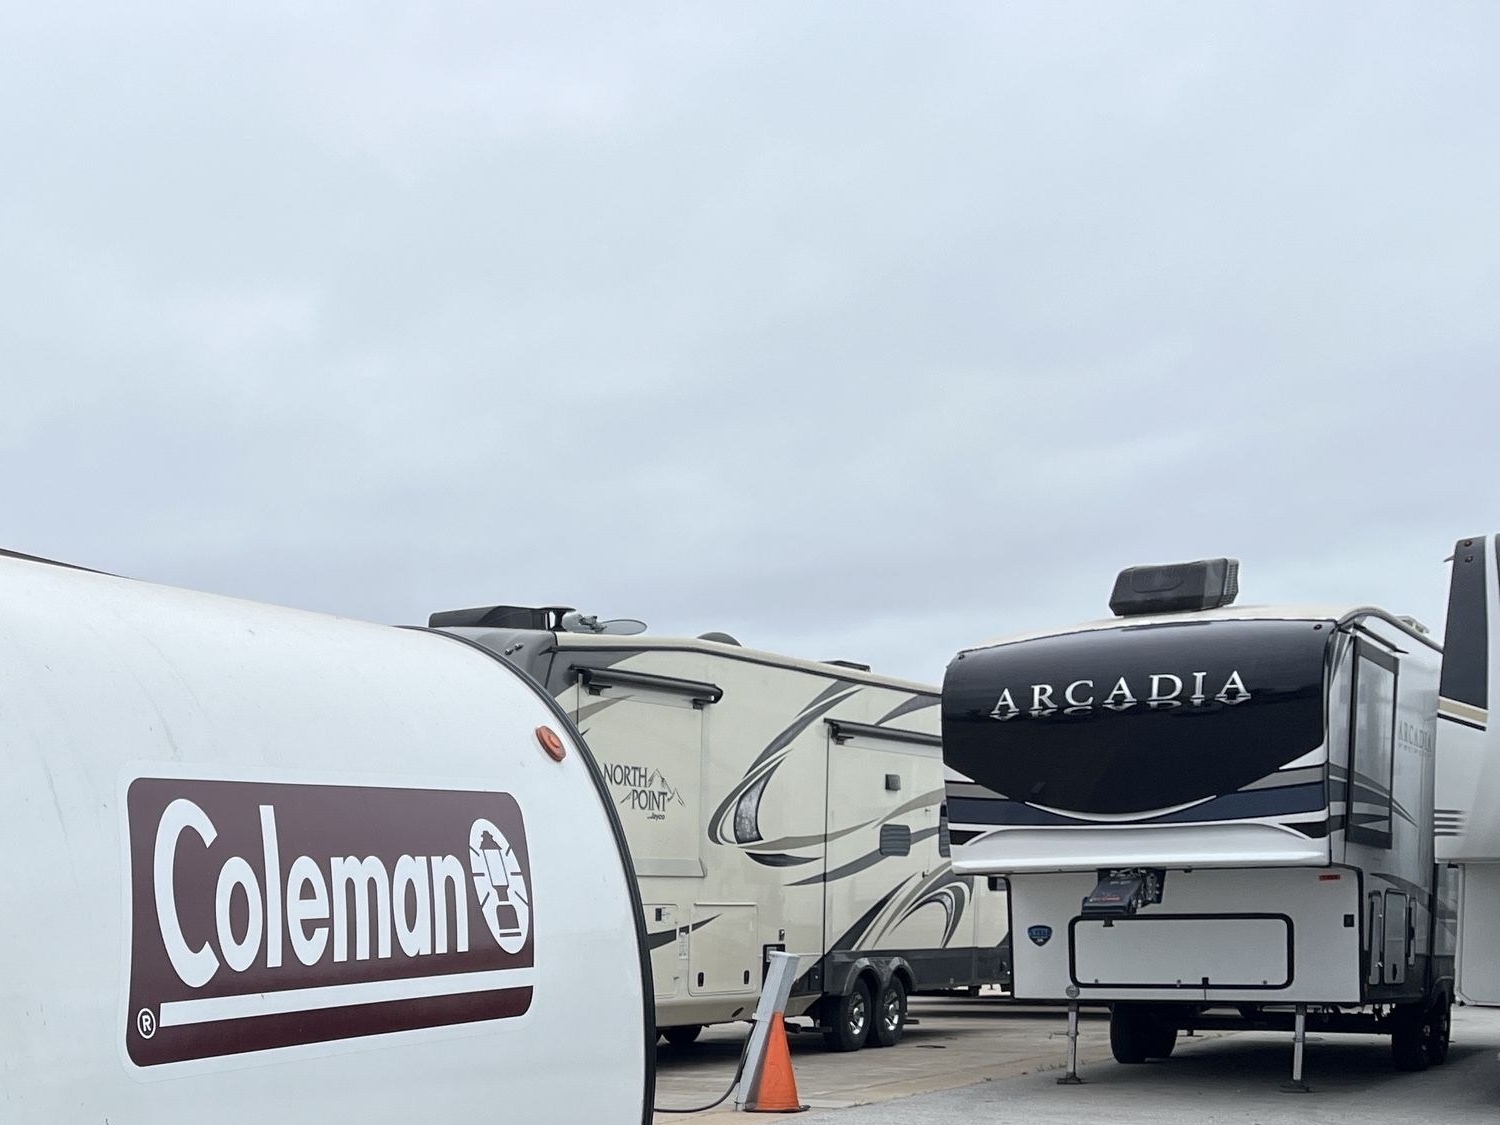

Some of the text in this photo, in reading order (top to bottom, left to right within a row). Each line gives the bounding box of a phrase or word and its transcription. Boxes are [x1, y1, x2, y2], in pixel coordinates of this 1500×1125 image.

[989, 670, 1252, 715] ARCADIA
[603, 763, 647, 788] NORTH
[631, 789, 667, 811] POINT
[153, 798, 469, 988] Coleman
